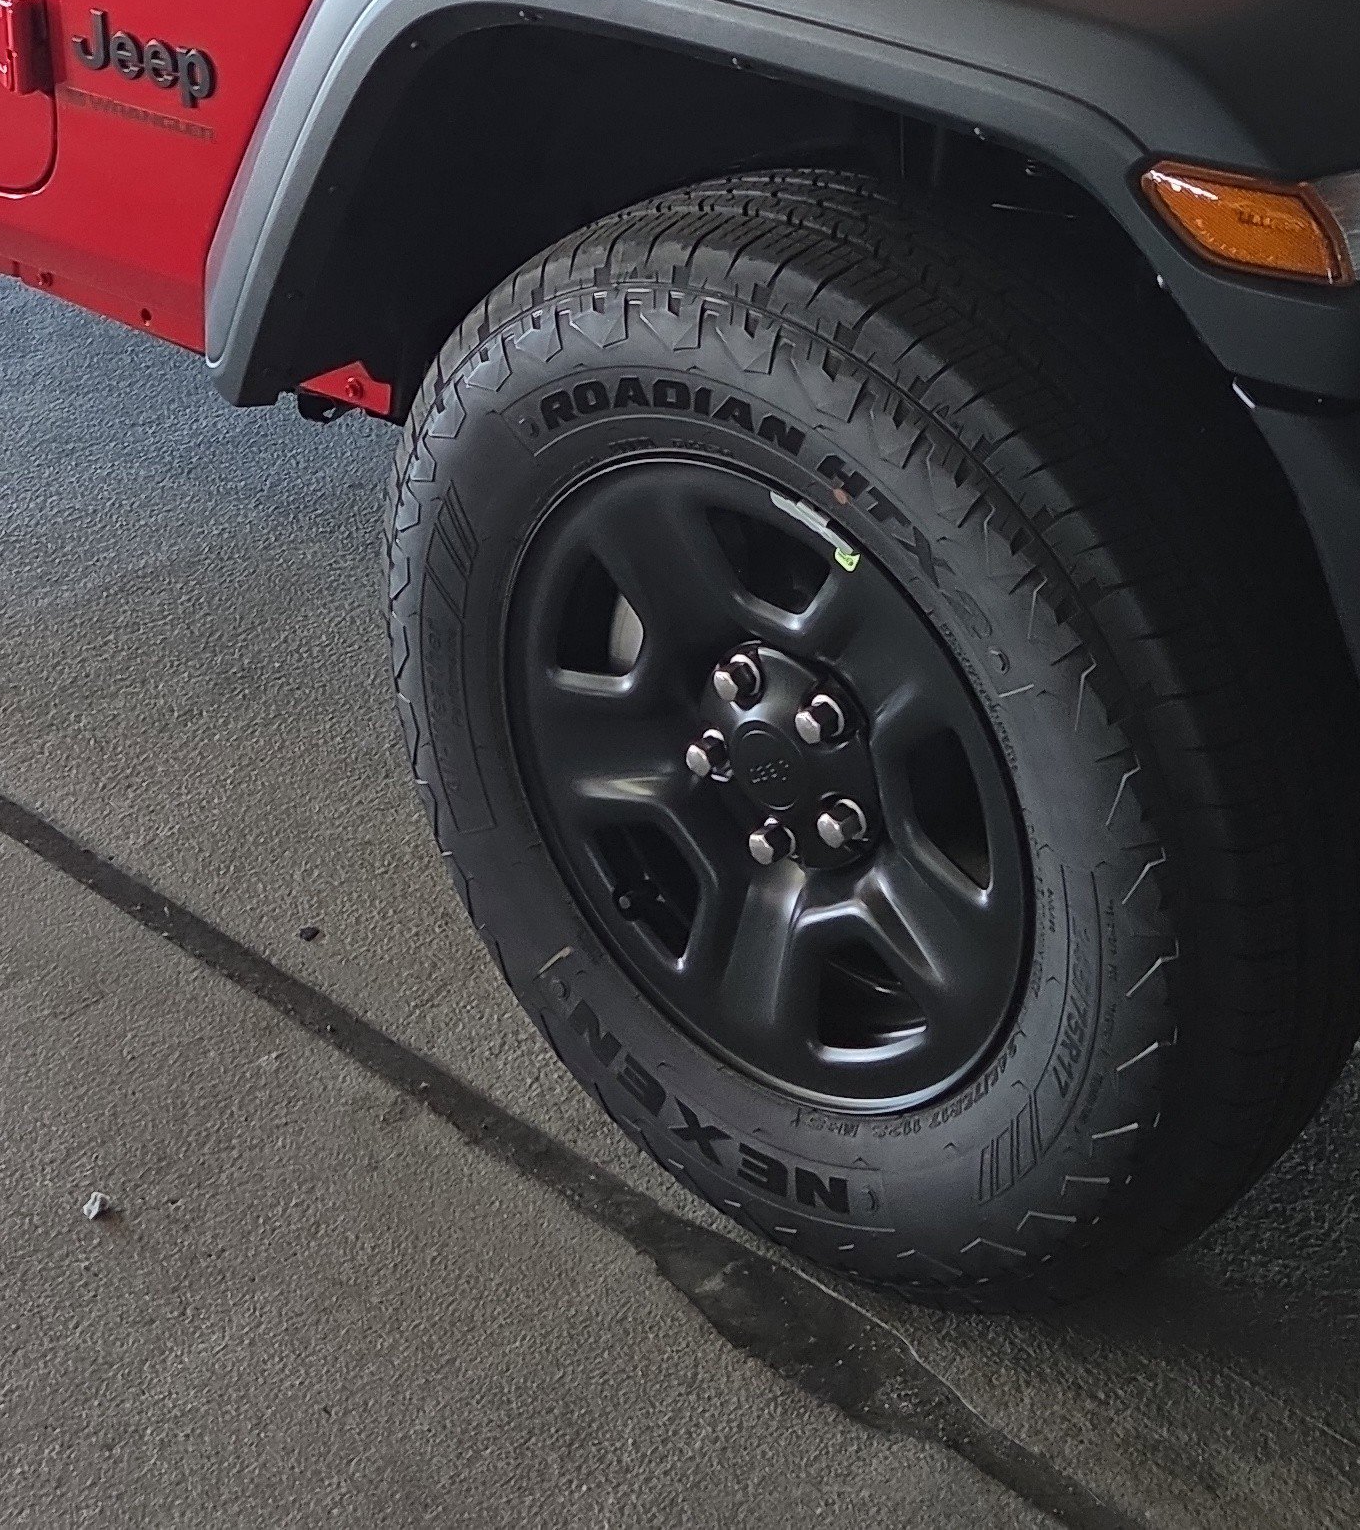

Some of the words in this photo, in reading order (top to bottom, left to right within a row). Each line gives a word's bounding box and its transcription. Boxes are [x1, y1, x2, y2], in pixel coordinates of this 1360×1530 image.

[71, 7, 217, 108] Jeep
[540, 377, 805, 459] ROADIAN
[566, 1001, 849, 1212] NEXEN
